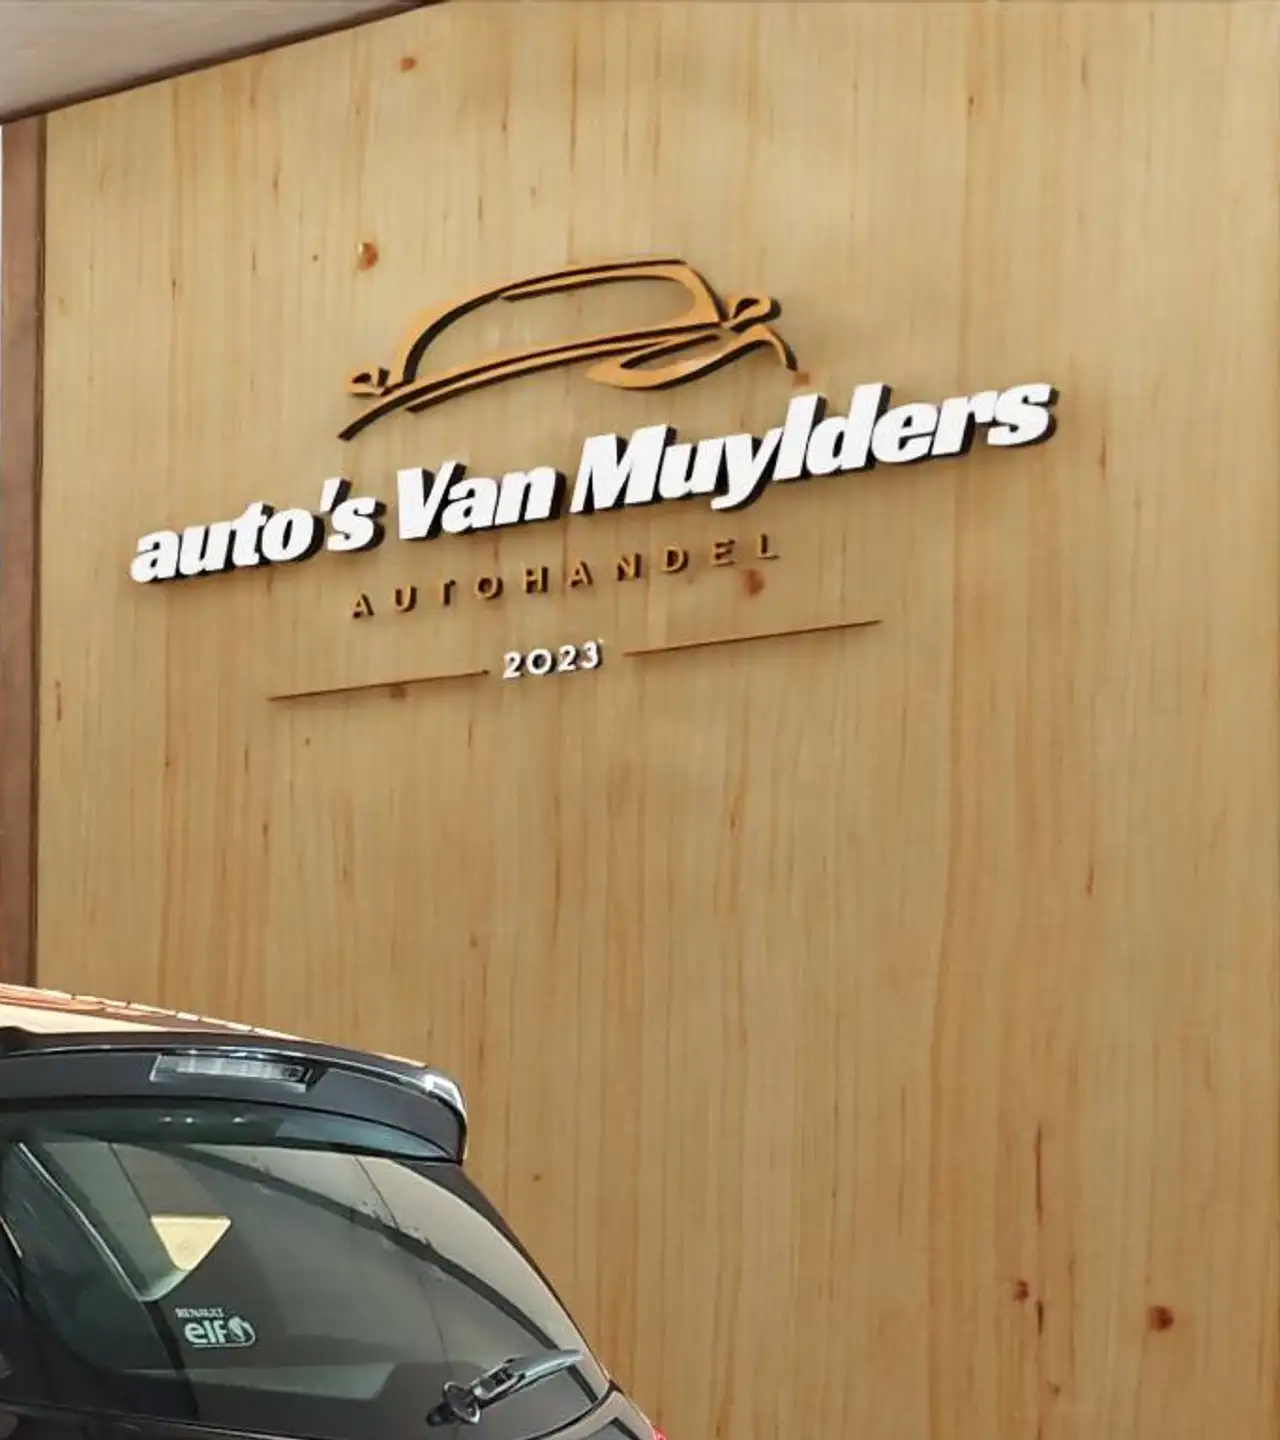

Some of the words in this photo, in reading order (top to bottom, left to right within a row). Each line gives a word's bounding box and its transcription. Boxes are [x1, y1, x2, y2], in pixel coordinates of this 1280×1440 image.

[130, 478, 379, 583] auto's
[395, 458, 560, 542] Van
[570, 382, 1057, 511] Muylders
[351, 533, 779, 619] AUTOHANDEL
[502, 640, 604, 680] 2023
[184, 1319, 228, 1344] elf
